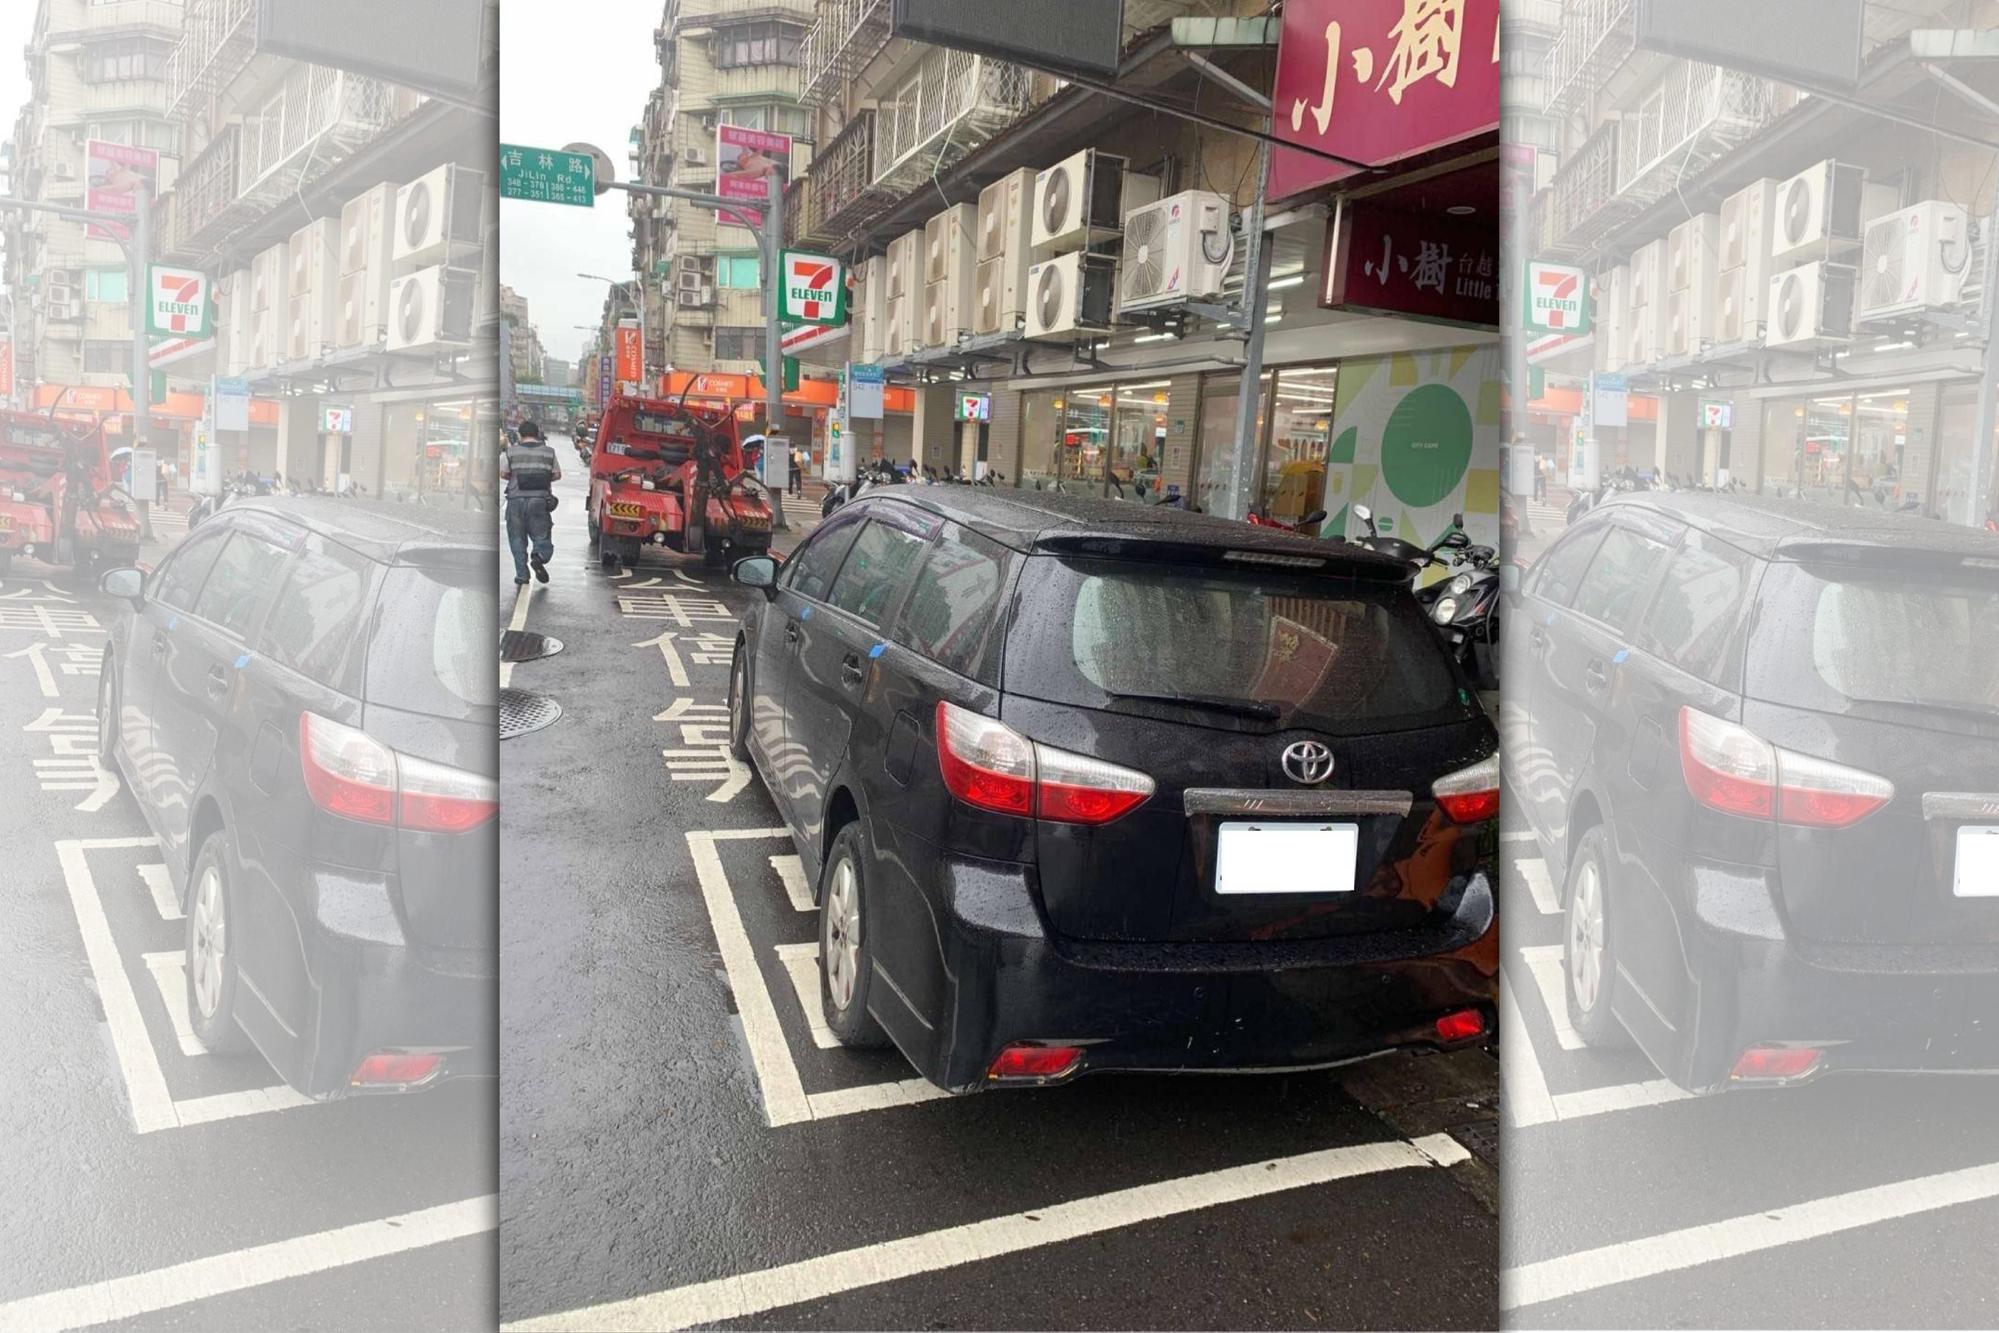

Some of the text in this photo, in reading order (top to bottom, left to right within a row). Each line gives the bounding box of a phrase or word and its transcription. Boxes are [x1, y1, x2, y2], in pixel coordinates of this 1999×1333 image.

[1291, 0, 1466, 136] 小樹
[507, 148, 583, 173] 吉林路
[1364, 234, 1453, 295] 小樹
[1455, 277, 1492, 300] Little
